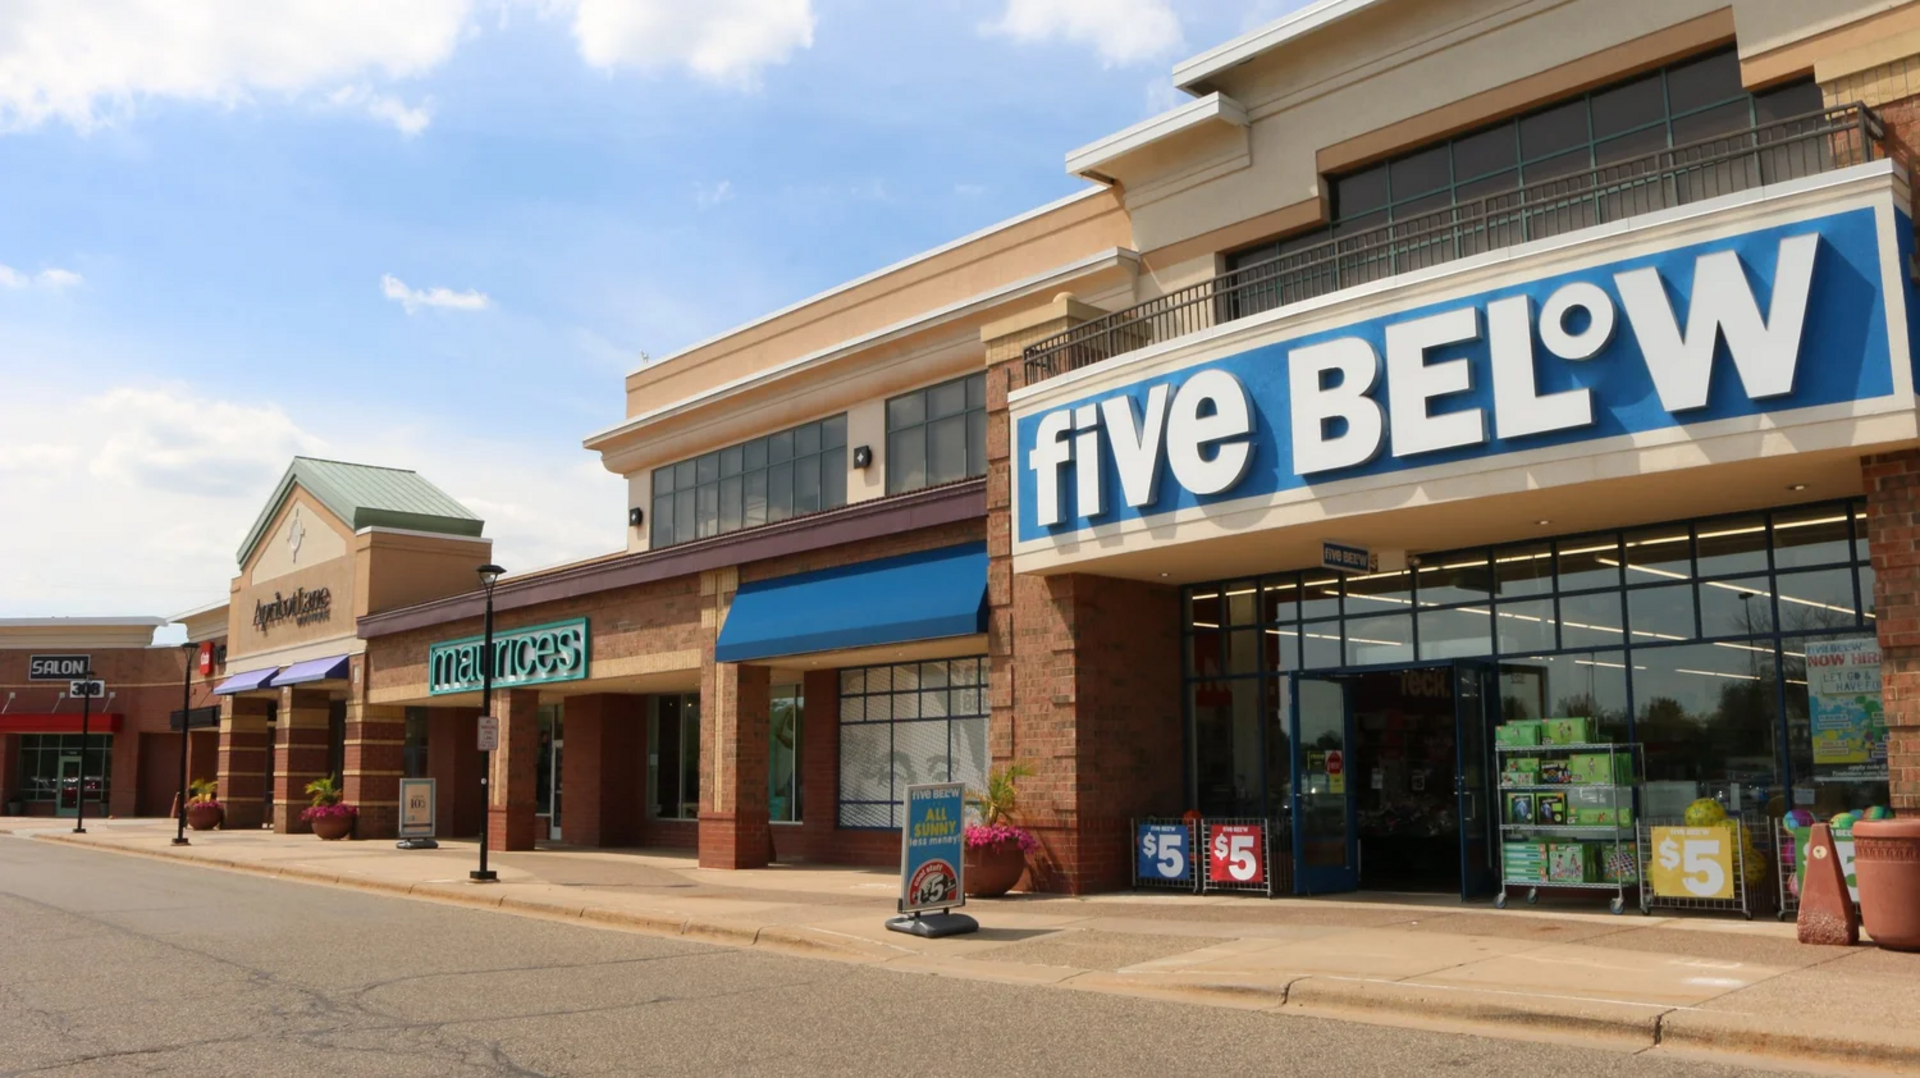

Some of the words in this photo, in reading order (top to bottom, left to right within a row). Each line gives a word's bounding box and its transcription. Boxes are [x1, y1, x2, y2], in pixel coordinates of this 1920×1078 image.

[1807, 653, 1845, 667] NOW
[1851, 651, 1883, 666] HIR
[31, 660, 85, 675] SALON
[1823, 671, 1842, 682] LET
[1836, 681, 1863, 691] HAVE
[925, 807, 947, 822] ALL
[914, 820, 956, 838] SUNNY
[1143, 832, 1184, 878] $5
[1214, 833, 1257, 881] $5
[1658, 836, 1725, 897] $5
